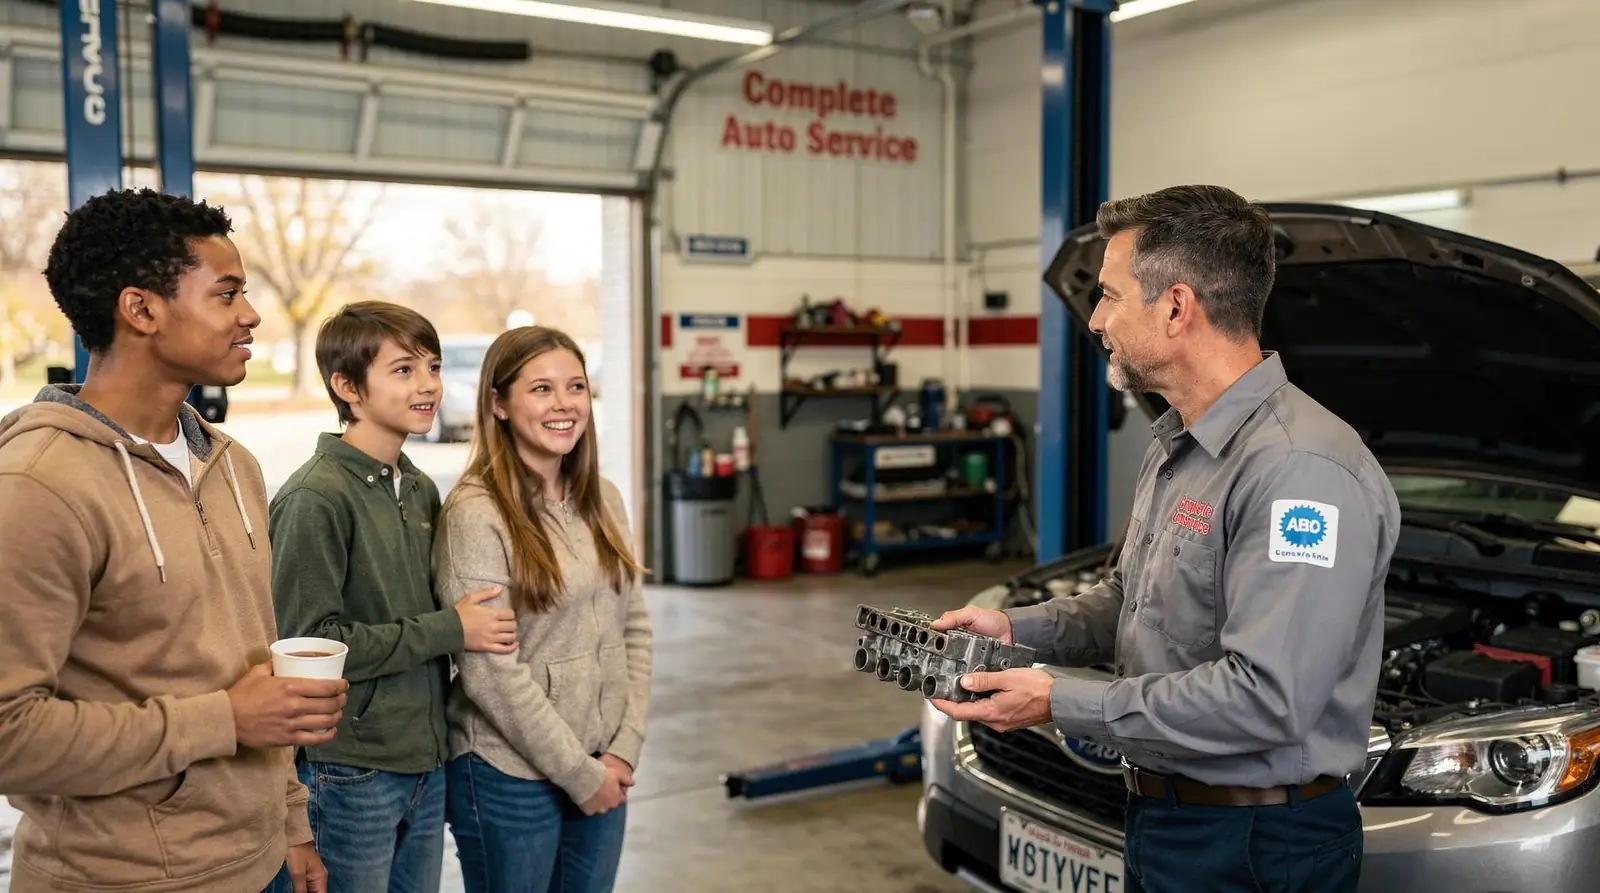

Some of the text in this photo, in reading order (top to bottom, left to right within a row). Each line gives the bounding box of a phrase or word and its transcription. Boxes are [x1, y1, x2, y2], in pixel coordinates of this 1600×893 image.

[743, 69, 897, 118] Complete
[722, 114, 919, 163] Auto Service
